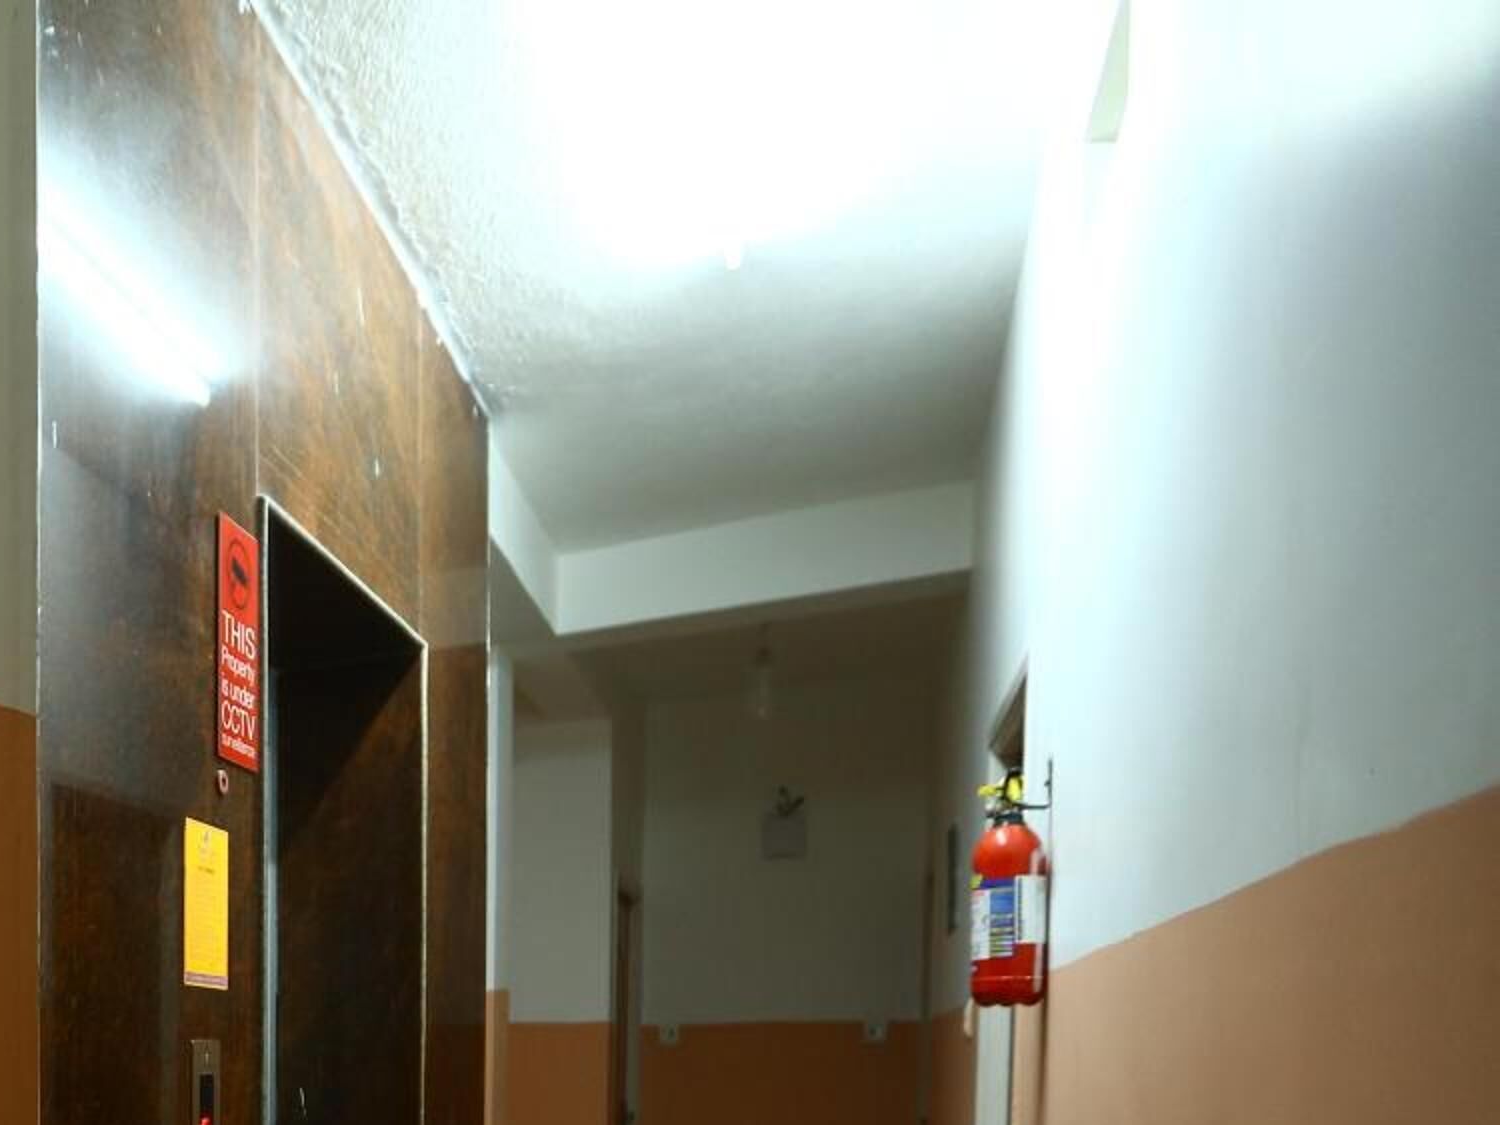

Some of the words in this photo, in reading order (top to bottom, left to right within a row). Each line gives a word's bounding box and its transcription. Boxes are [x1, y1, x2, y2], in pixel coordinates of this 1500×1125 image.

[222, 610, 255, 660] THIS
[230, 683, 255, 708] under
[221, 700, 256, 740] CCTV
